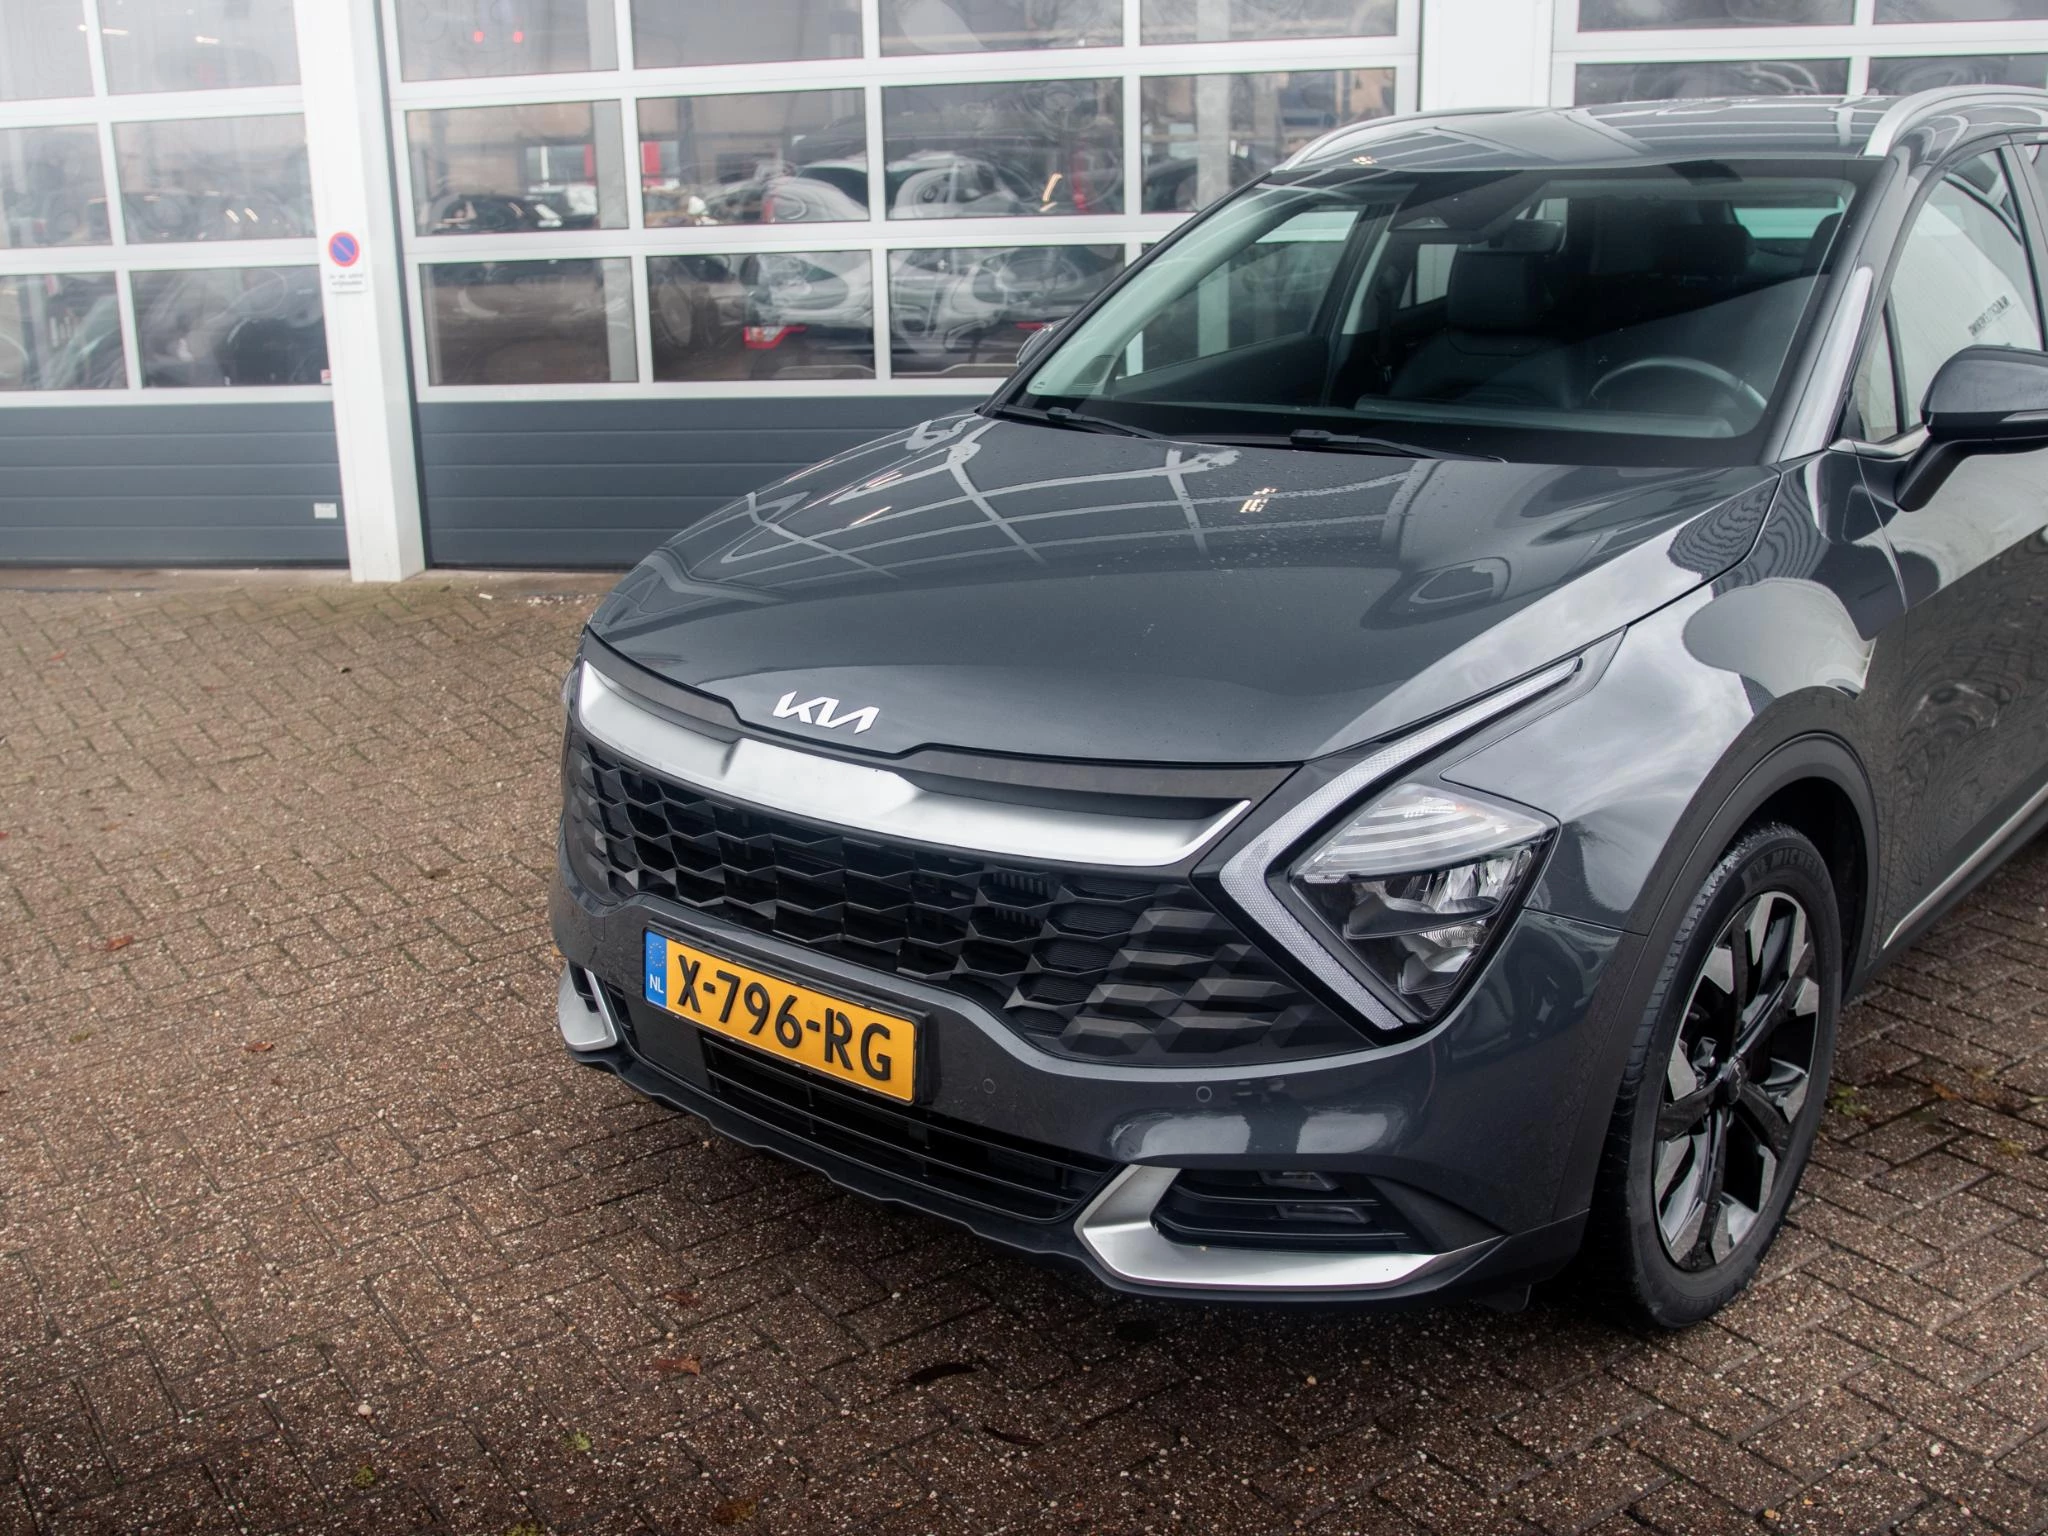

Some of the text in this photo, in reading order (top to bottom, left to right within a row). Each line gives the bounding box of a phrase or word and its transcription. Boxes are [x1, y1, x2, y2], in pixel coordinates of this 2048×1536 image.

[772, 691, 880, 734] KIA
[649, 973, 665, 994] NL
[677, 954, 892, 1081] X-796-RG
